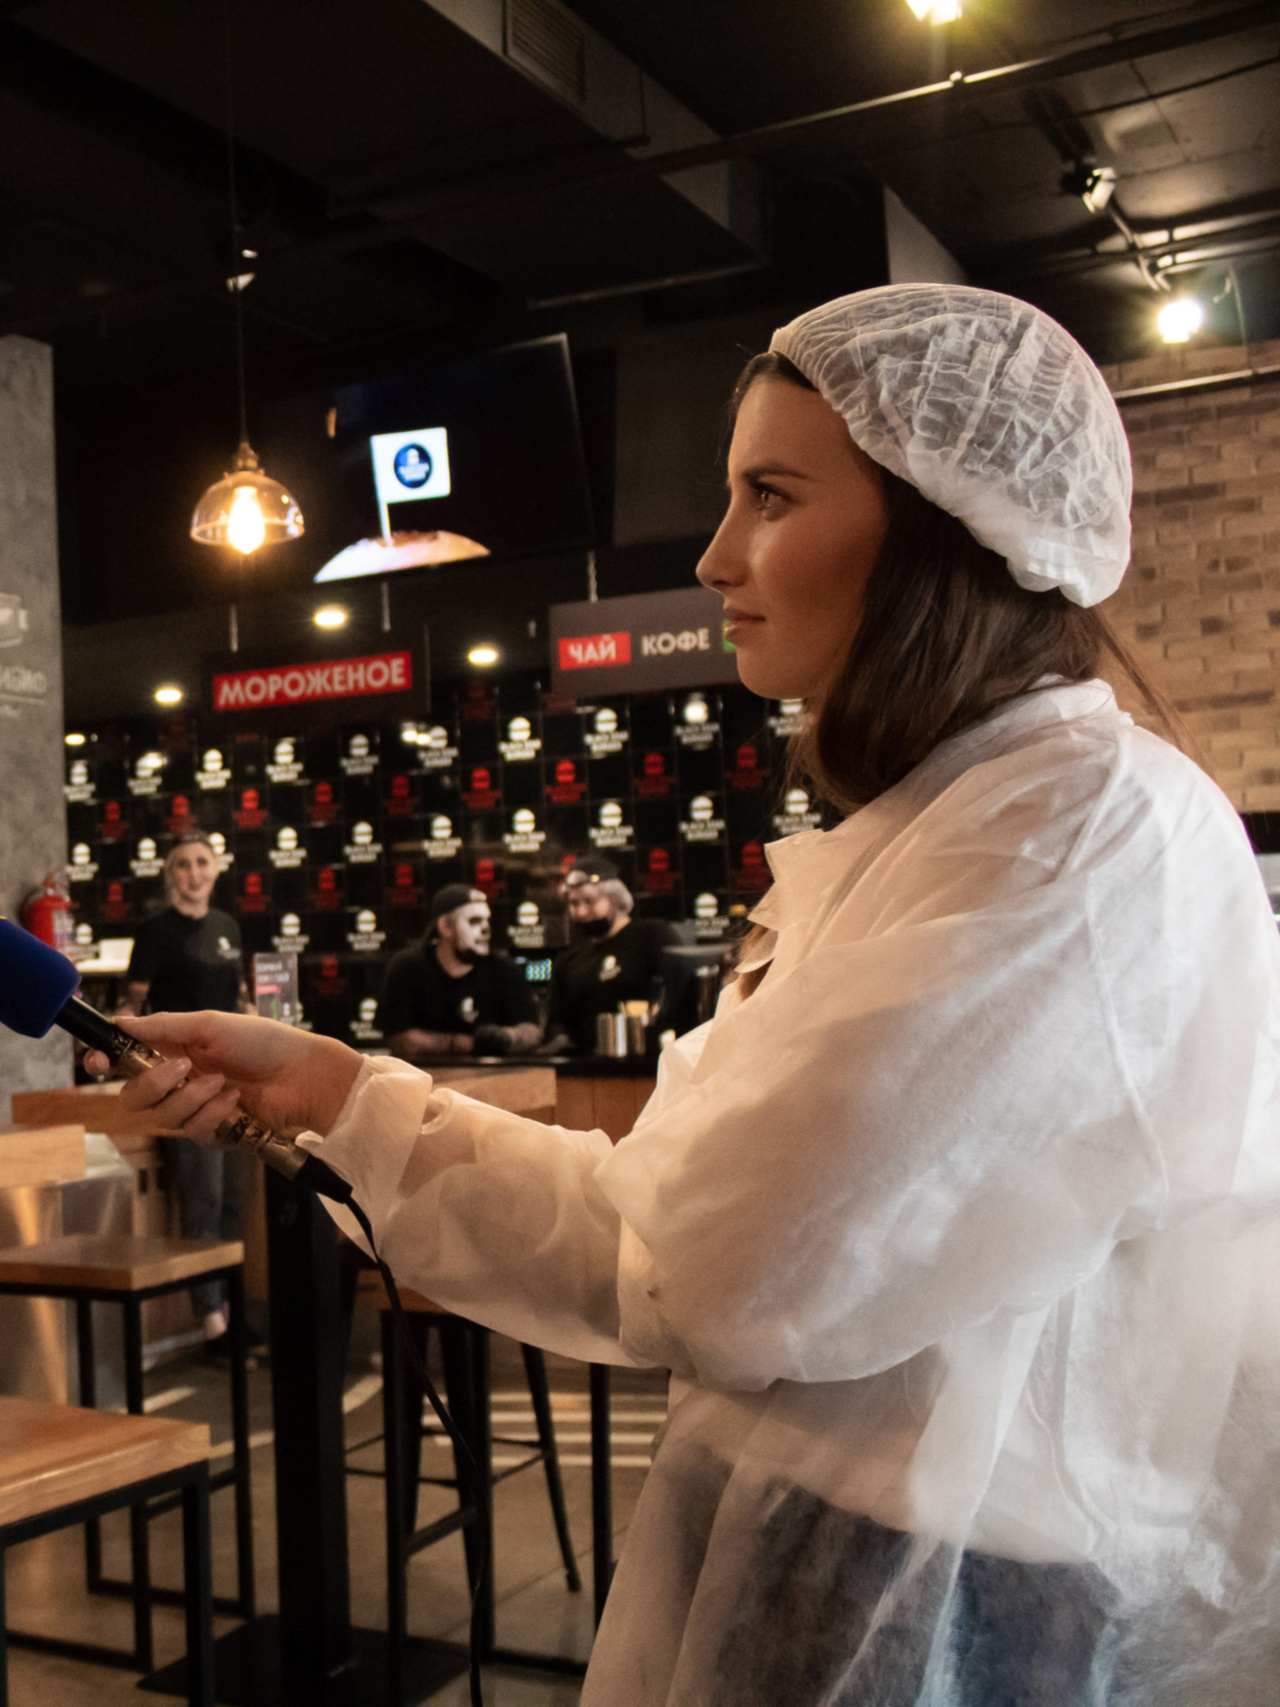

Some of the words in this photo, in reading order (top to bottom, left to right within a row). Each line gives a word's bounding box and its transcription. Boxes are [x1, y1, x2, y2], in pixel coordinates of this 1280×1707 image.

[569, 634, 616, 663] ЧАЙ
[641, 627, 710, 656] КОФЕ
[220, 658, 406, 707] МОРОЖЕНОЕ
